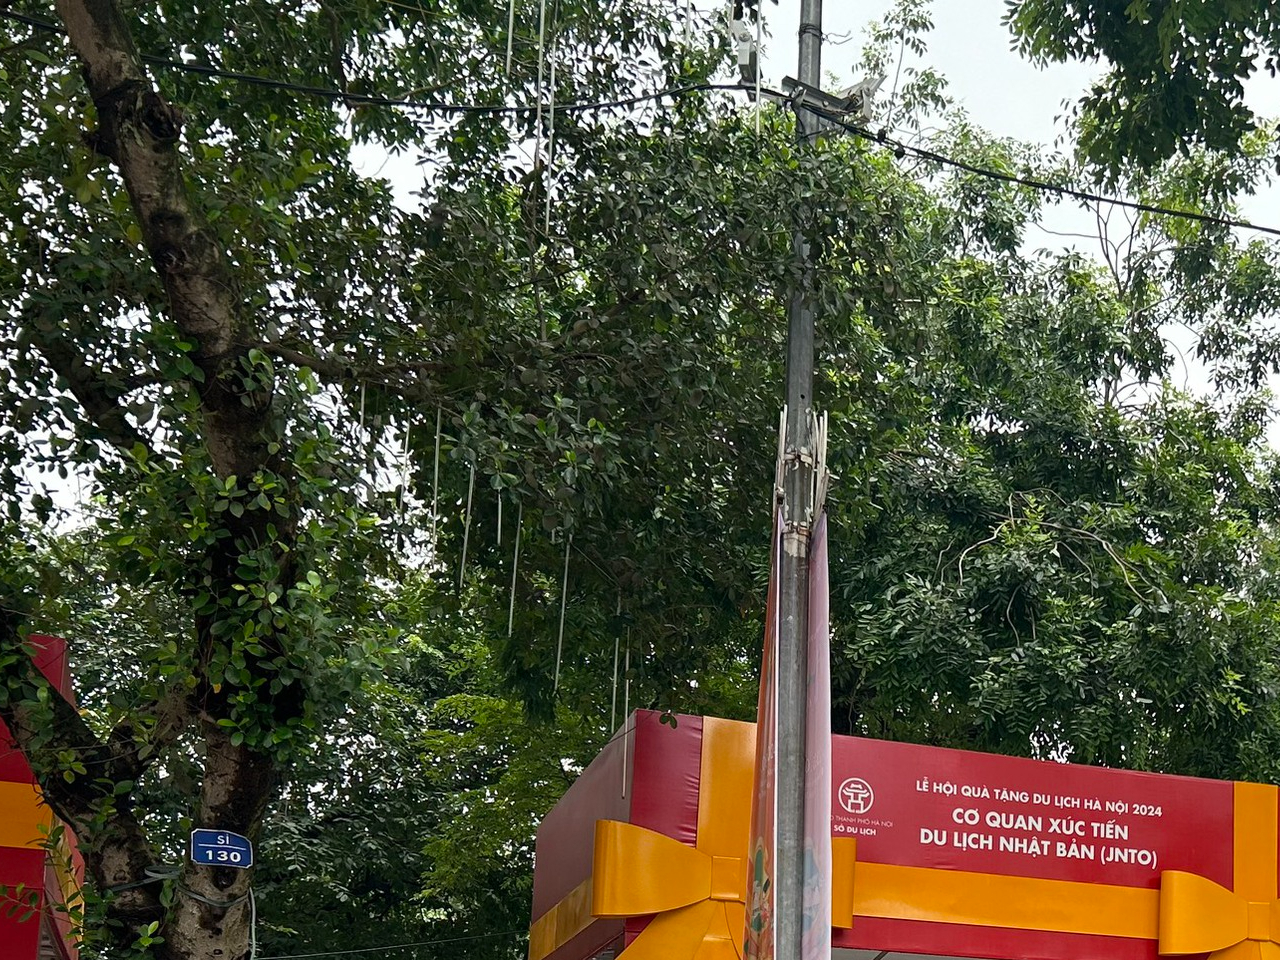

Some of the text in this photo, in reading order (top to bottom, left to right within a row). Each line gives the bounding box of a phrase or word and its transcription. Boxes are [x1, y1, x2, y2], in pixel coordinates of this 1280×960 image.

[916, 776, 1162, 817] LỄ HỘI QUÀ TẶNG DU LỊCH HÀ NỘI 2024
[847, 826, 858, 834] DU
[860, 828, 876, 836] LỊCH
[952, 808, 1128, 840] CƠ QUAN XÚC TIẾN
[206, 850, 240, 862] 130
[920, 828, 1157, 869] DU LỊCH NHẬT BẢN (JNTO)
